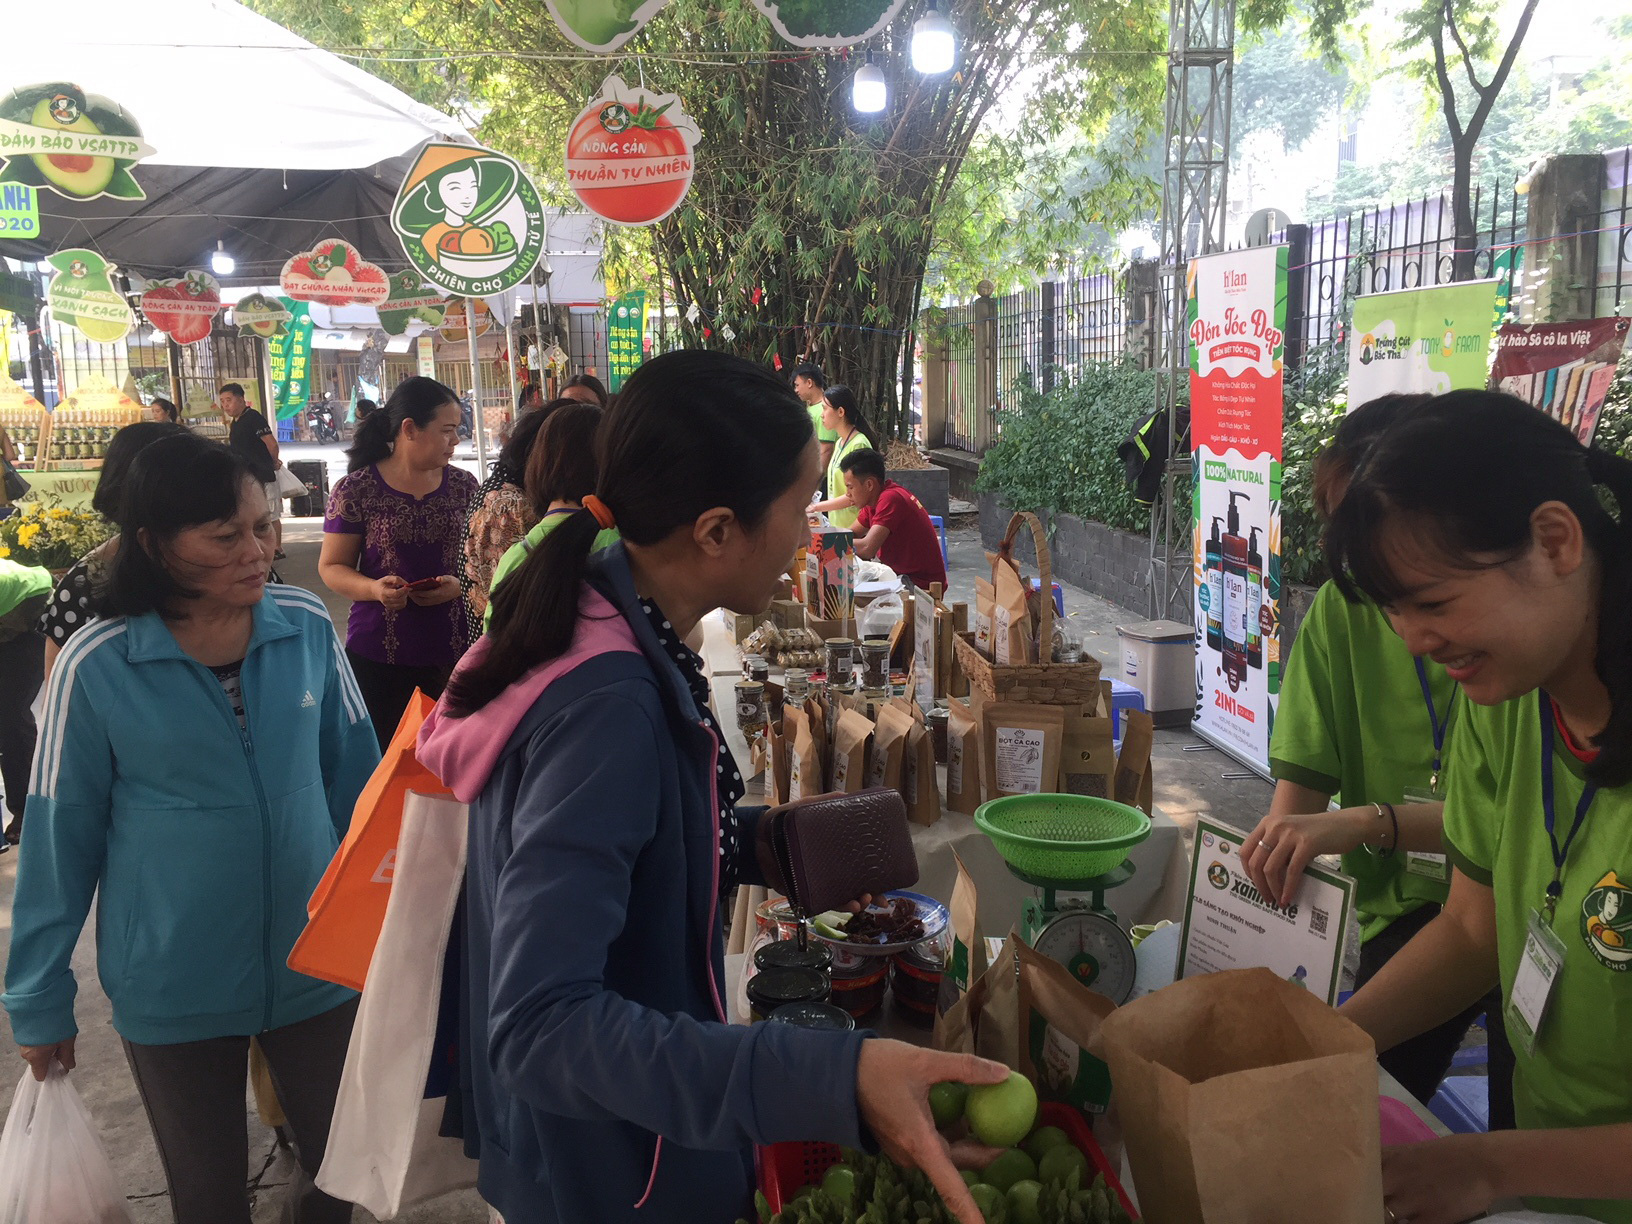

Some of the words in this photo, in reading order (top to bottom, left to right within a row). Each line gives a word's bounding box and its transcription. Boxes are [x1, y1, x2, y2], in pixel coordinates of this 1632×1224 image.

[41, 131, 74, 151] BẢO
[78, 138, 139, 155] VSATTP
[582, 139, 619, 154] NÔNG
[623, 138, 648, 154] SẢN
[567, 163, 618, 182] THUẦN
[621, 166, 643, 182] TỰ
[645, 158, 691, 177] NHIÊN
[525, 210, 541, 226] TẾ
[528, 228, 541, 247] TỬ
[505, 250, 535, 283] XANH
[427, 264, 467, 291] PHIÊN
[471, 277, 503, 292] CHỢ
[51, 298, 88, 313] XANH
[92, 305, 129, 319] SẠCH
[1190, 319, 1220, 346] Đón
[1224, 307, 1247, 336] Tóc
[1251, 309, 1281, 355] Đẹp
[1398, 335, 1411, 347] Cút
[1508, 333, 1528, 347] hào
[1528, 332, 1541, 347] Sô
[1543, 331, 1555, 346] cô
[1557, 331, 1568, 346] la
[1570, 330, 1592, 348] Việt
[1455, 334, 1481, 353] FARM
[1206, 464, 1226, 479] 100%
[1226, 469, 1264, 485] NATURAL
[1214, 689, 1237, 717] 2IN1
